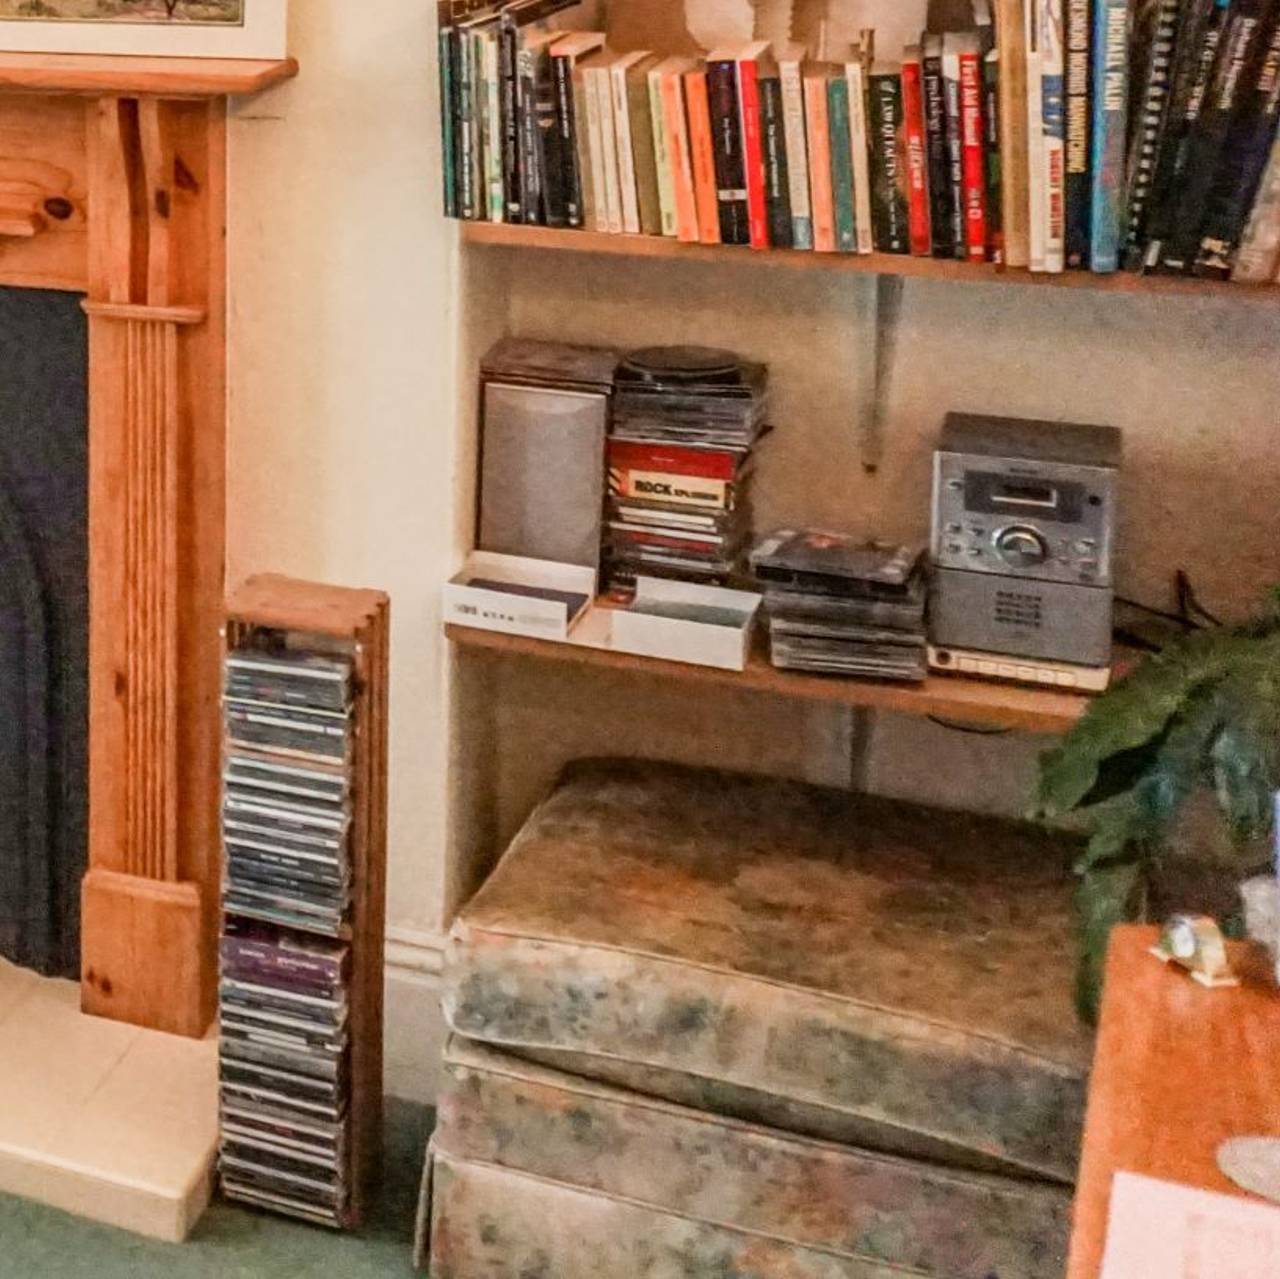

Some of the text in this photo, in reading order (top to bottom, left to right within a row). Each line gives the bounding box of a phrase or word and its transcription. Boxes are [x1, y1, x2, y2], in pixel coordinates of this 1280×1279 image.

[1103, 7, 1126, 110] MICHAEL PALIN
[961, 60, 977, 86] First
[962, 87, 978, 105] Aid
[883, 140, 896, 176] FACTS
[634, 479, 671, 495] ROCK
